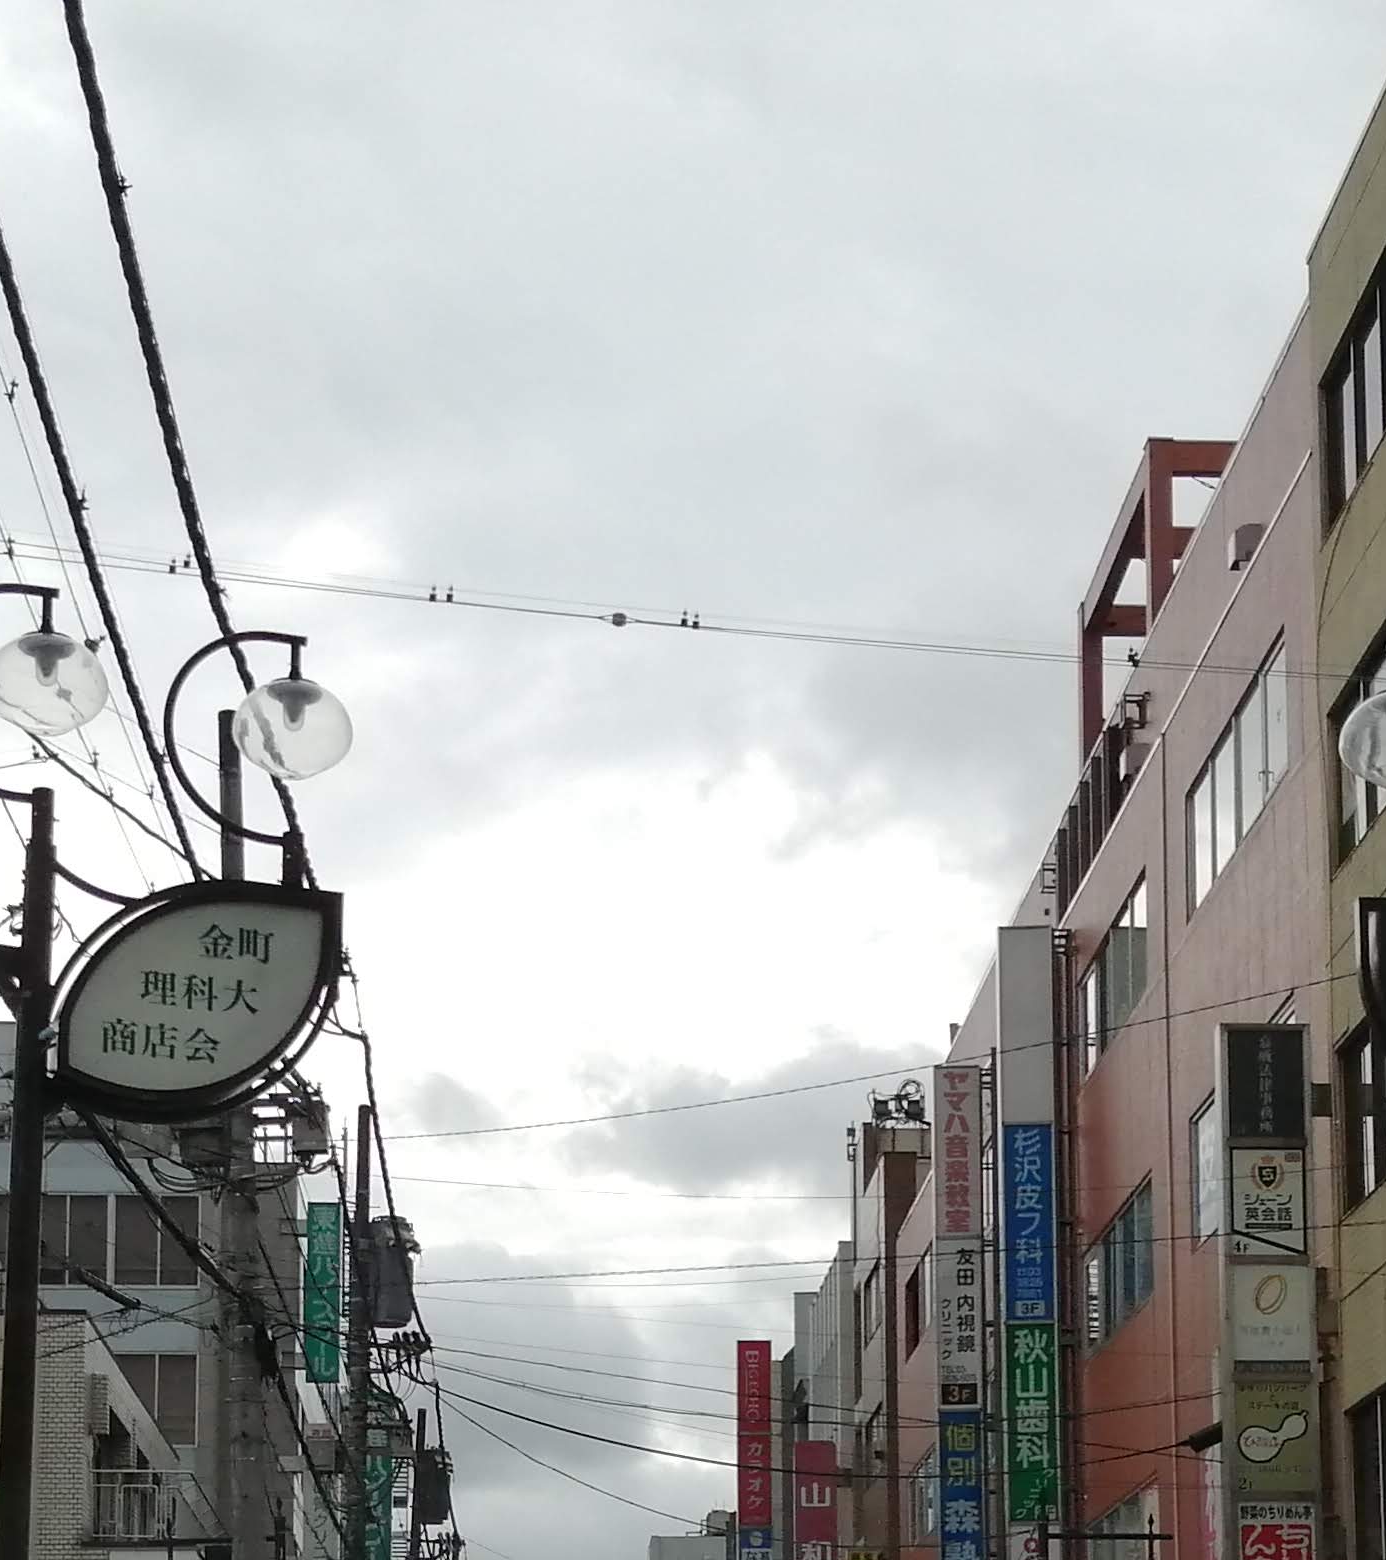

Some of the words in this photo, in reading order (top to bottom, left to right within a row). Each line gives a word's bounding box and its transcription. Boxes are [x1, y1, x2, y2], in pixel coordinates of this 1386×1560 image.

[198, 924, 274, 965] 金町
[140, 970, 260, 1015] 理科大
[101, 1018, 221, 1064] 商店会
[1014, 1129, 1043, 1264] 杉沢皮フ科
[1244, 1194, 1292, 1206] シェーン
[1245, 1207, 1292, 1221] 英会話
[957, 1248, 974, 1286] 友田
[941, 1299, 951, 1361] クリニック
[957, 1295, 975, 1352] 内視鏡
[1022, 1302, 1040, 1315] 3F
[1014, 1329, 1049, 1469] 秋山歯科
[747, 1442, 765, 1510] カラオケ
[946, 1422, 975, 1486] 個別
[1240, 1505, 1312, 1519] 野菜のちりめん亭
